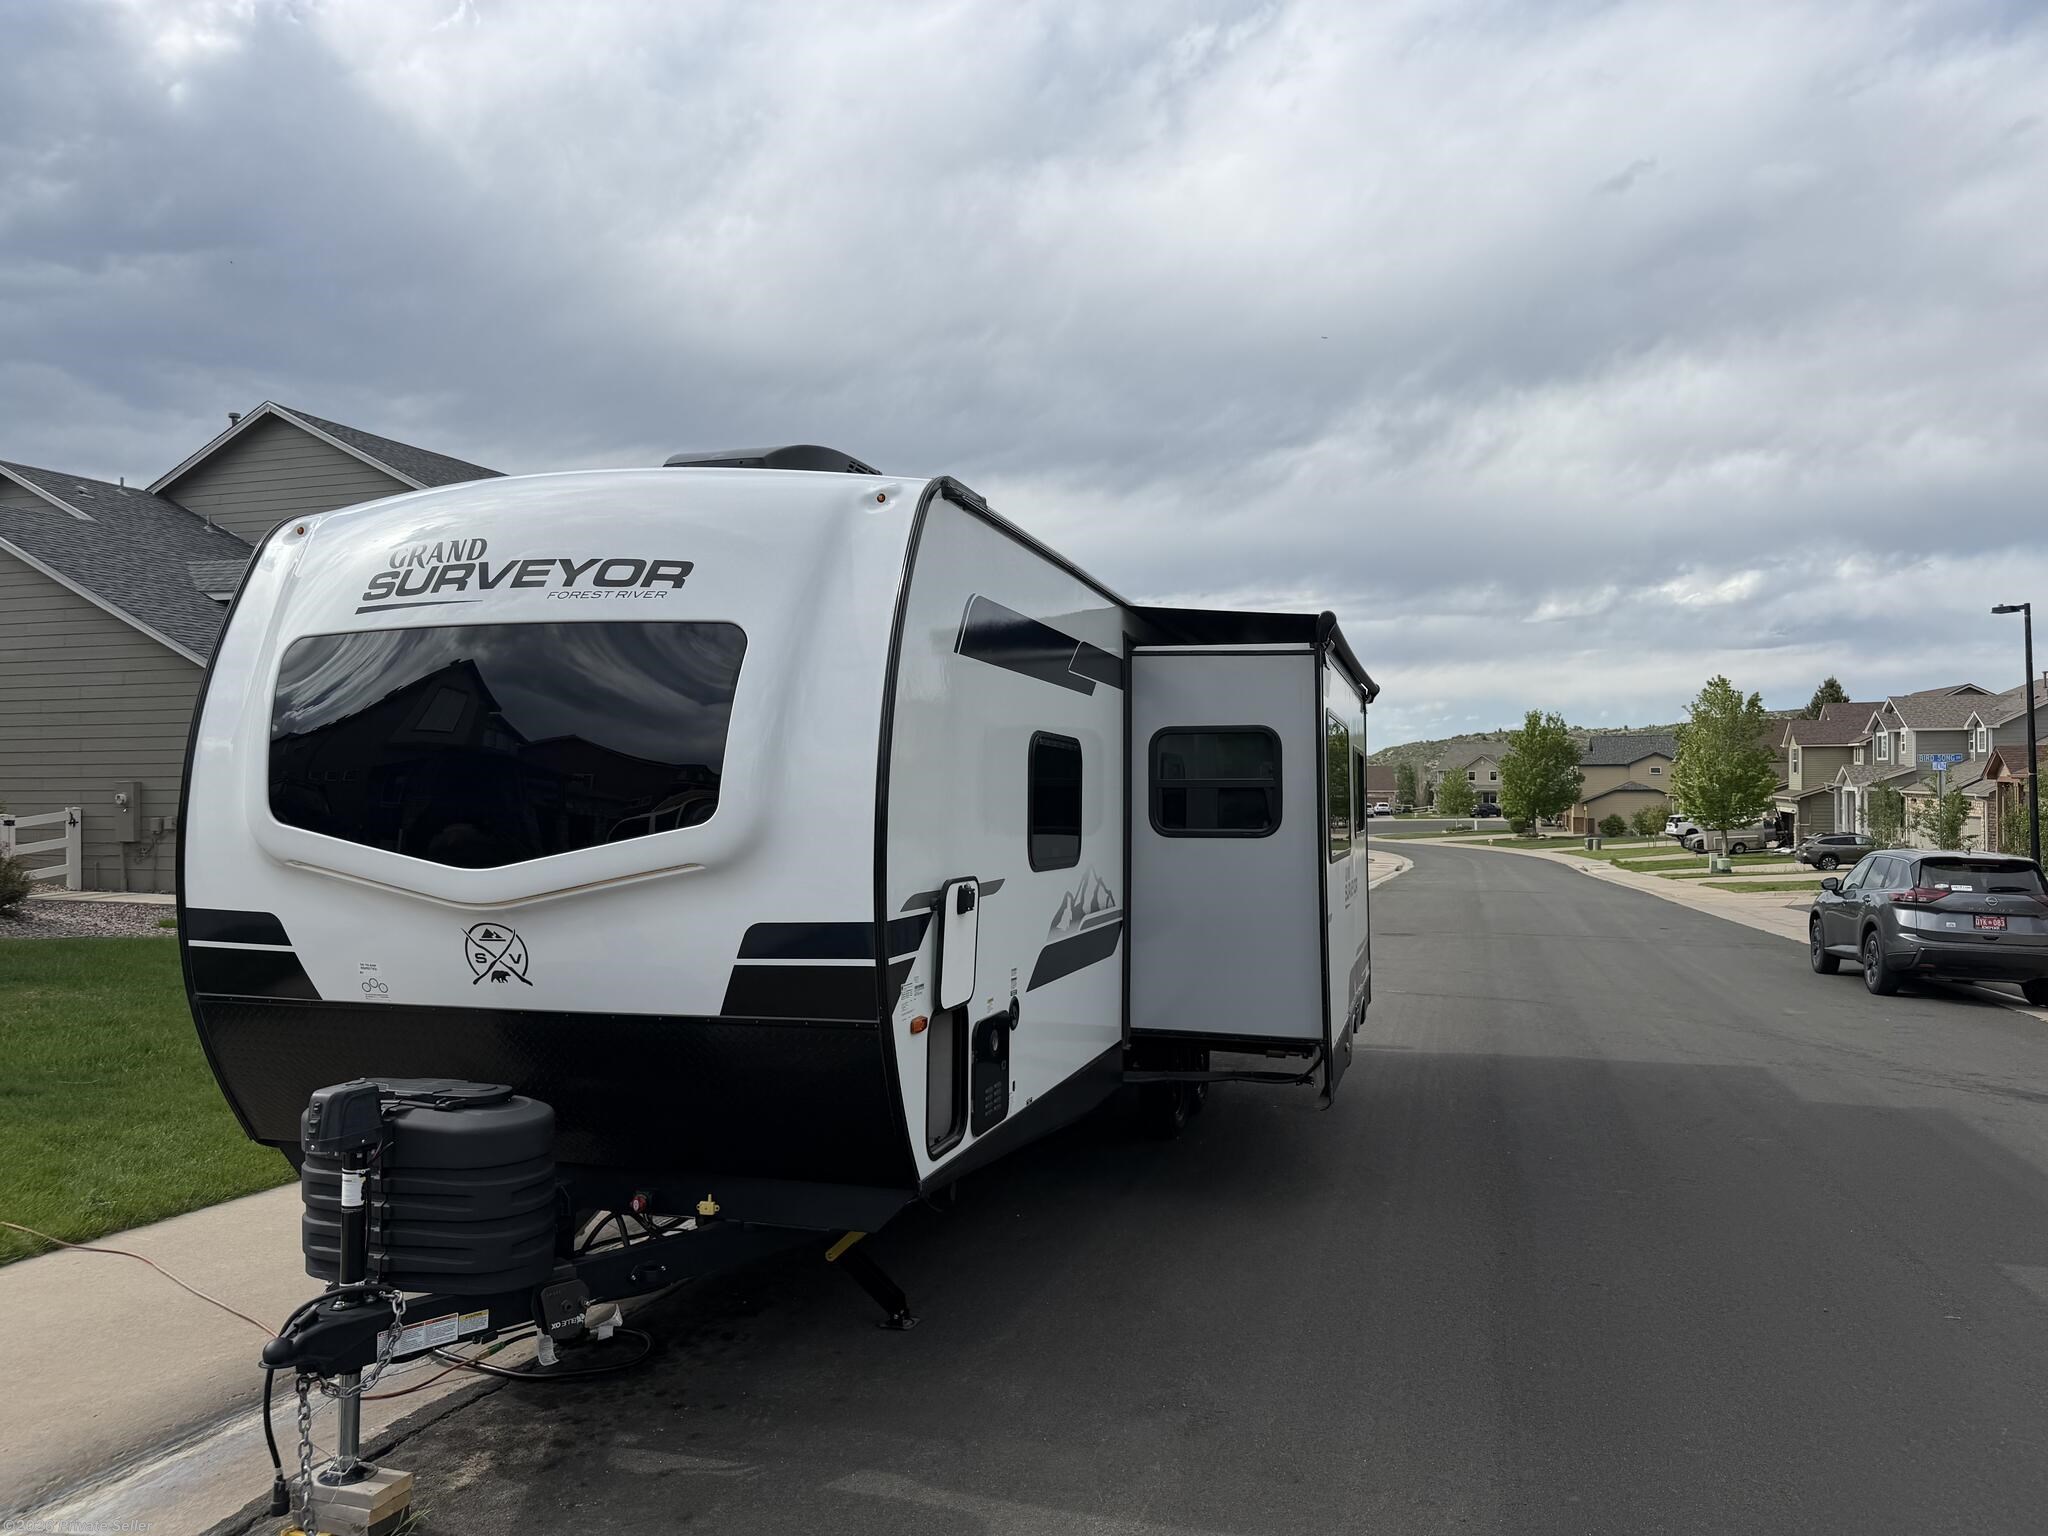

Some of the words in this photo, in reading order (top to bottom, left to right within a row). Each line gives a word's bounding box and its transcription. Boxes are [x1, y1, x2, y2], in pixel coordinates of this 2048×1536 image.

[389, 538, 487, 569] GRAND
[362, 558, 694, 601] SURVEYOR
[547, 590, 612, 599] FOREST
[616, 590, 668, 599] RIVER
[1937, 754, 1955, 762] SONG
[475, 953, 487, 963] S
[509, 954, 521, 964] V
